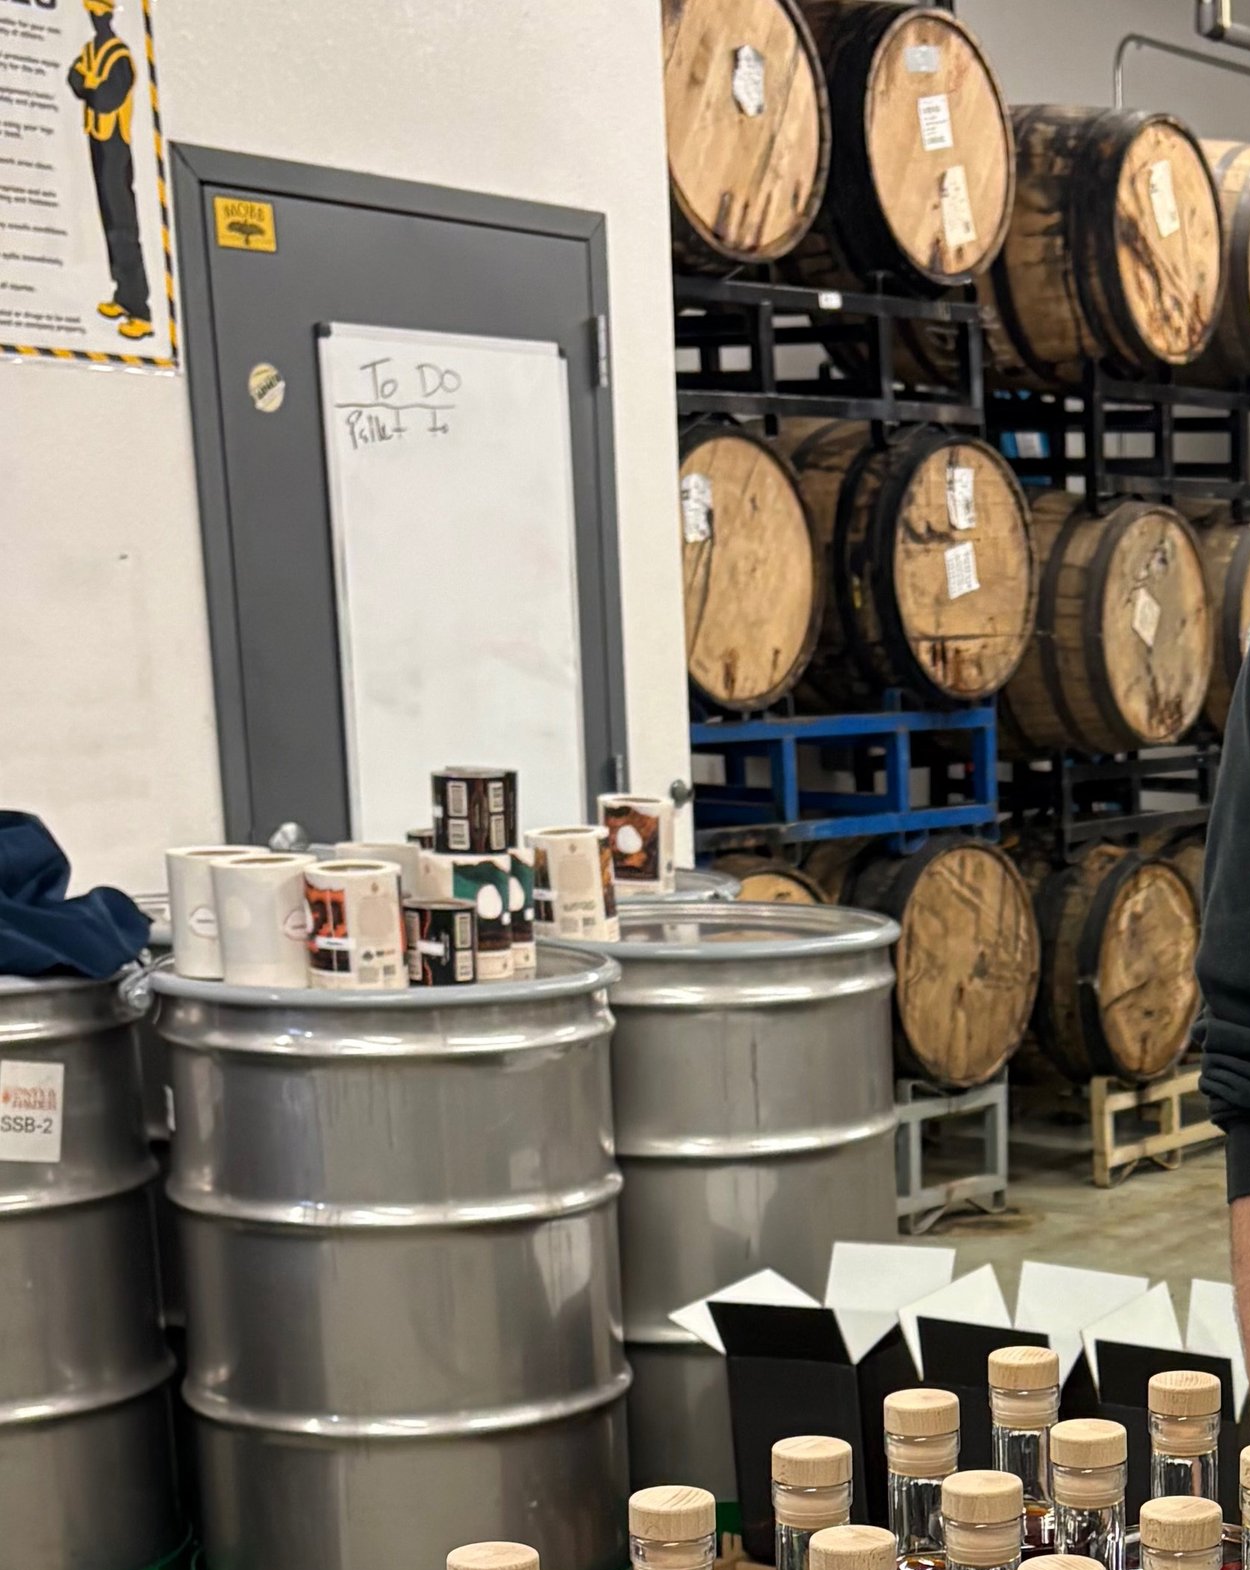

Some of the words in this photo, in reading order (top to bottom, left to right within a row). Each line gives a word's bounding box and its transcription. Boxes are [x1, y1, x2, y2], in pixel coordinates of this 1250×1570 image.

[359, 357, 399, 401] To
[415, 362, 462, 398] Do
[0, 1114, 54, 1135] SSB-2
